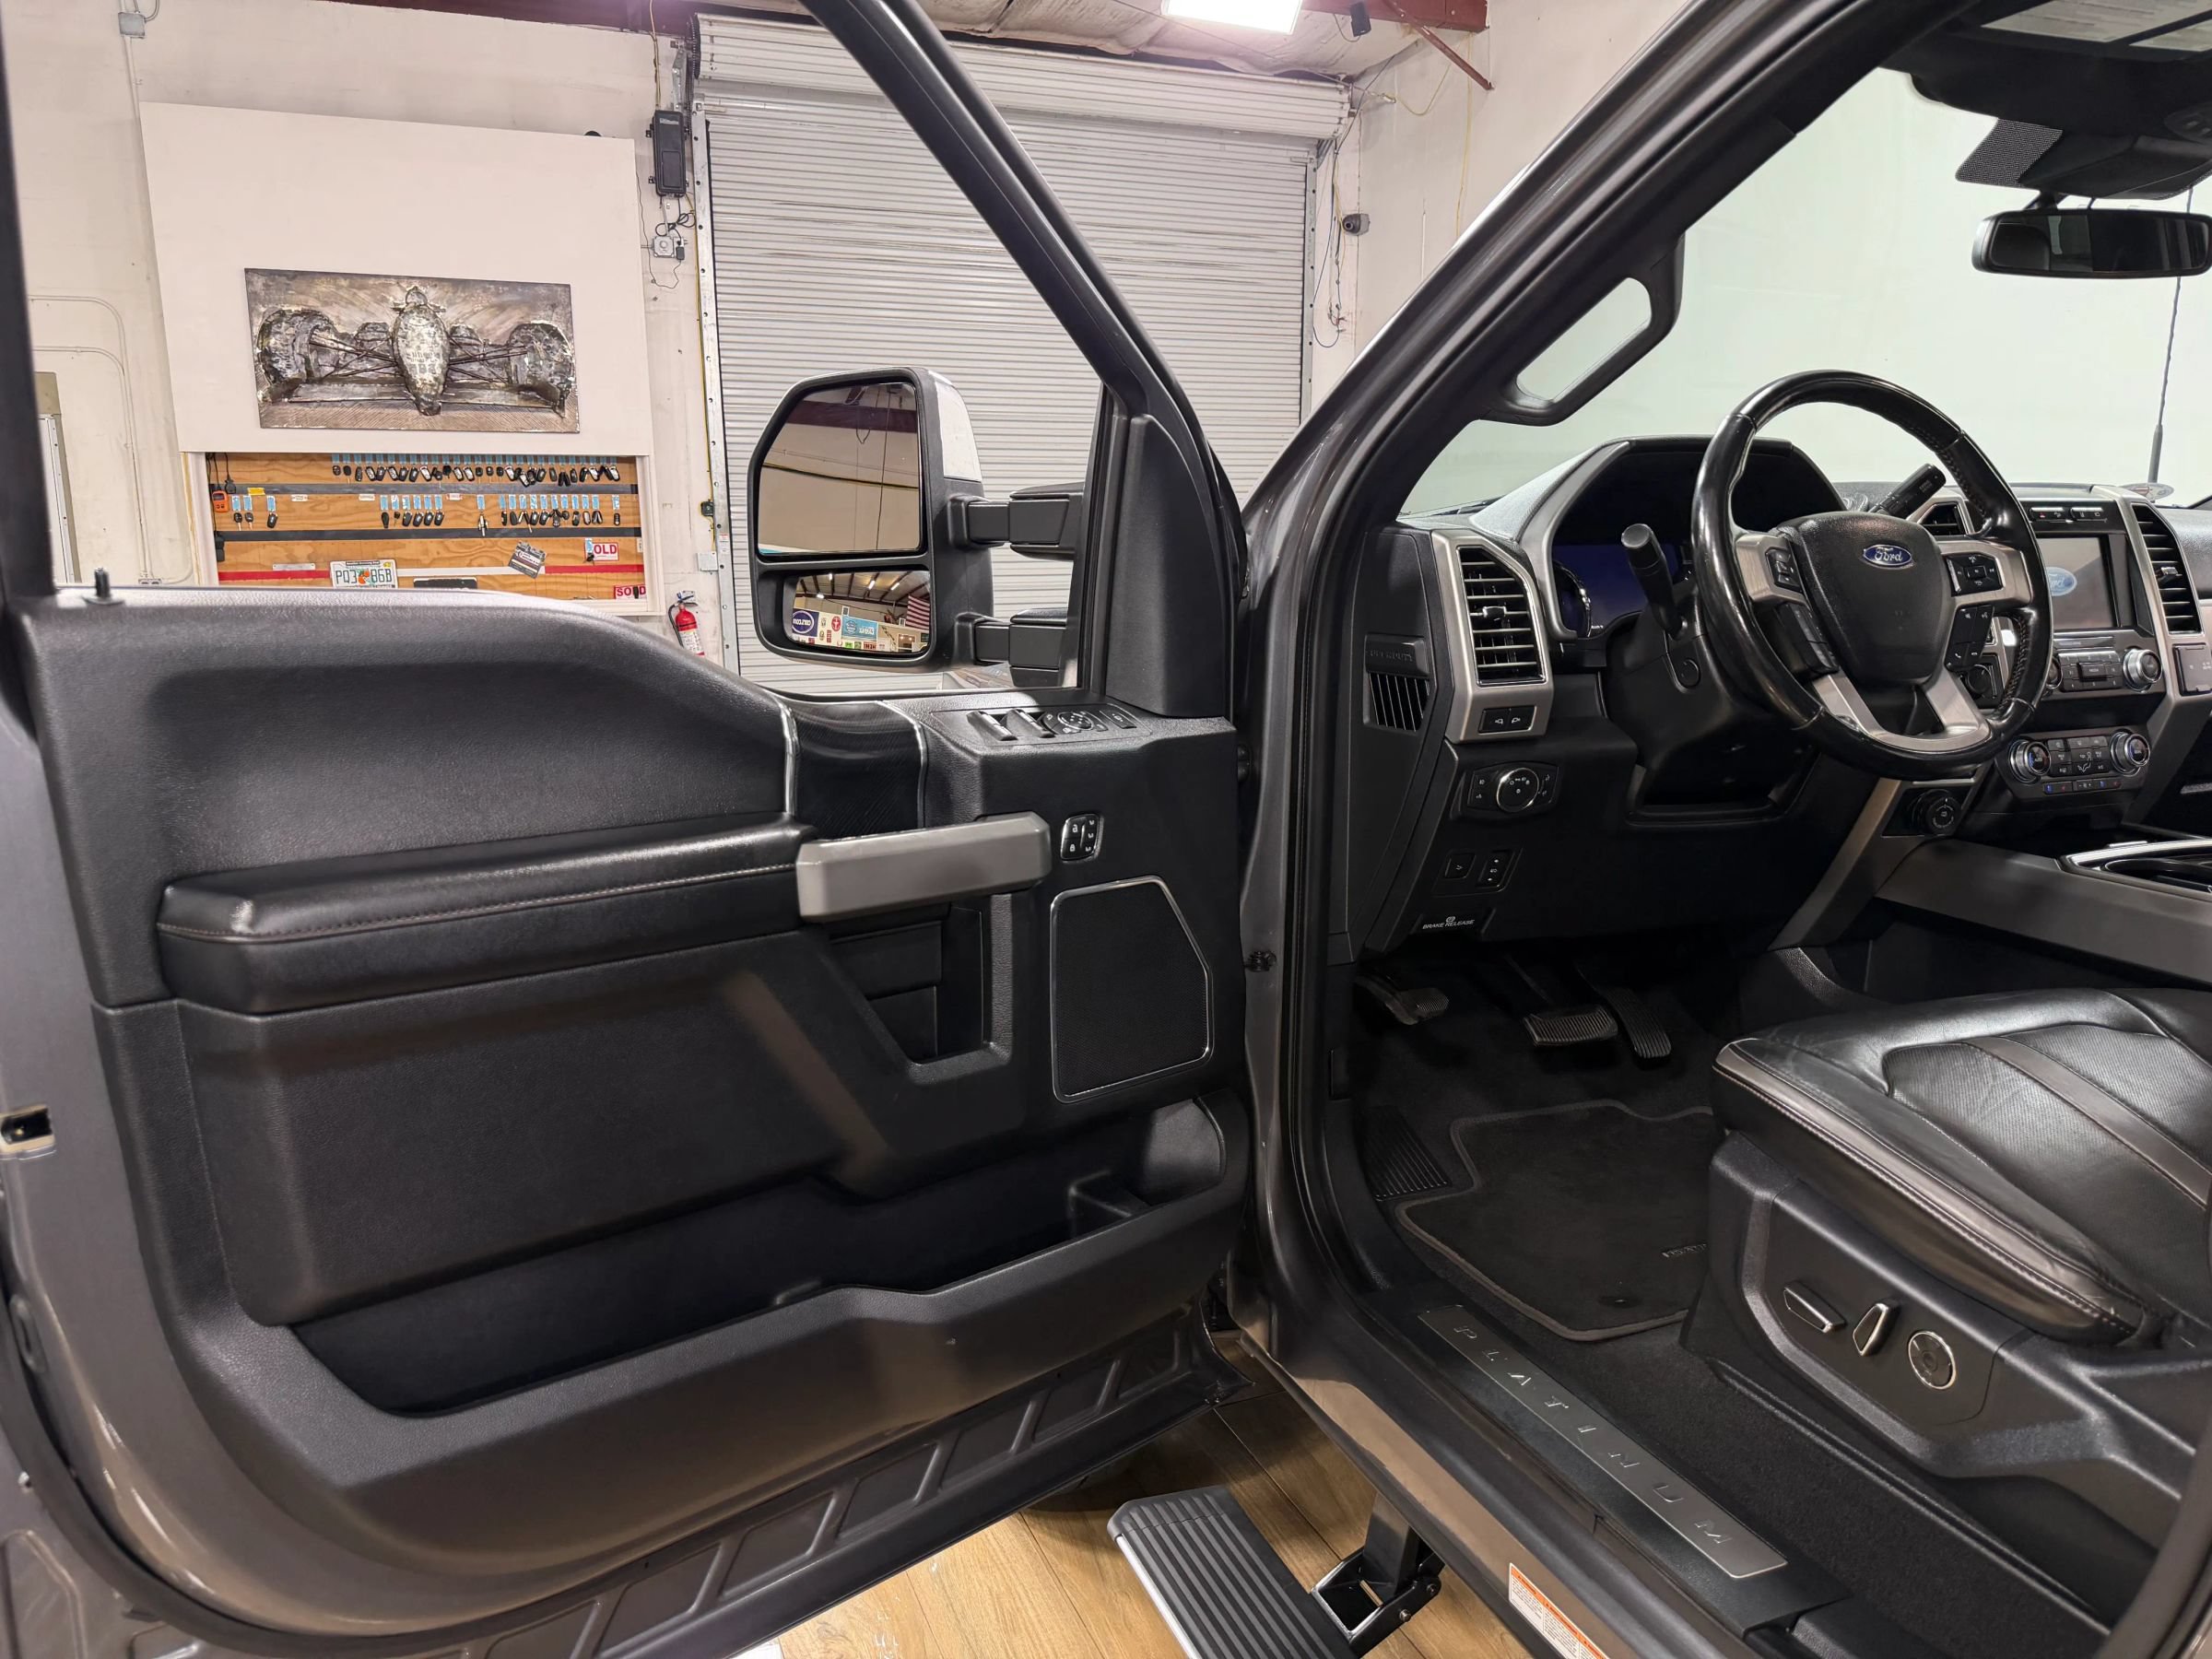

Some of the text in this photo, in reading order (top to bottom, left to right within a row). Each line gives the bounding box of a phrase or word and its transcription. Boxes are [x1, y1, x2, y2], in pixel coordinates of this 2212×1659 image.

[593, 544, 617, 554] OLD
[1875, 547, 1902, 560] Ford
[617, 586, 646, 596] SOD
[1453, 1325, 1733, 1545] PLATINUM
